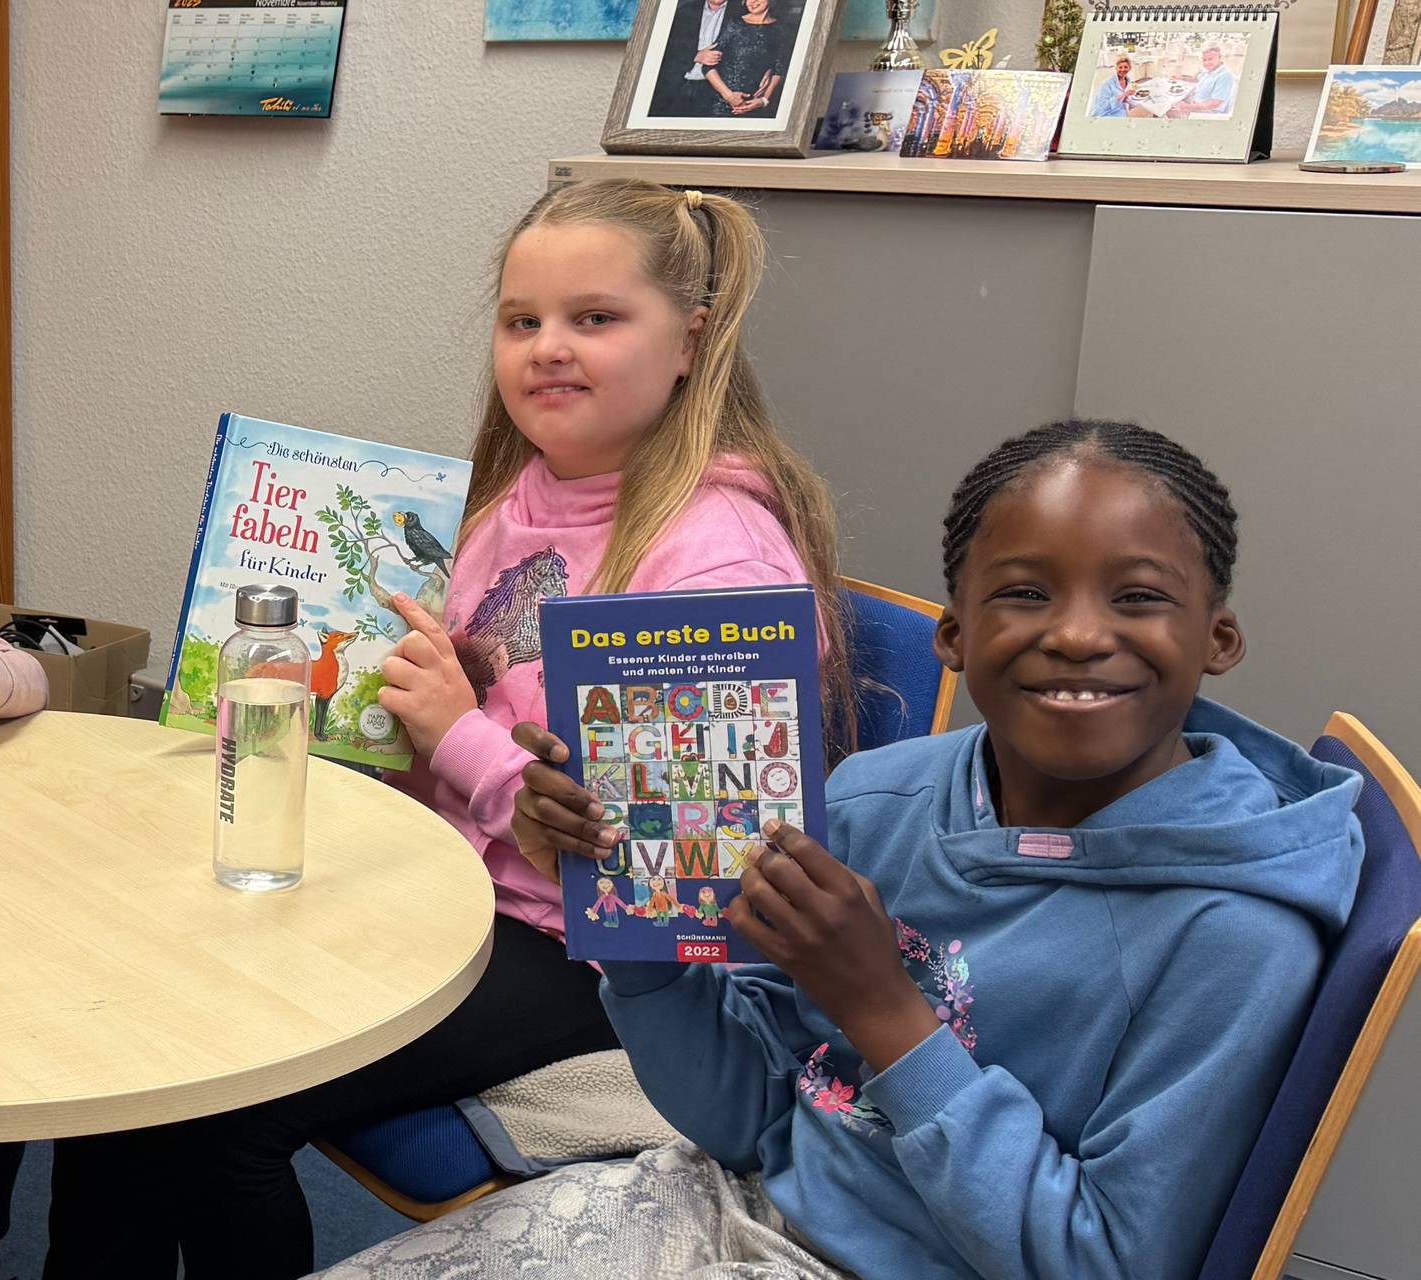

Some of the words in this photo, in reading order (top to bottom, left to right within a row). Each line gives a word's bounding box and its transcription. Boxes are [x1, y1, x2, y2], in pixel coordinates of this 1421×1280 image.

[267, 441, 290, 458] Die
[292, 449, 359, 472] schönsten
[249, 460, 307, 511] Tier
[229, 503, 319, 554] fabeln
[240, 549, 267, 572] für
[269, 557, 327, 583] Kinder
[571, 628, 627, 648] Das
[636, 624, 710, 646] erste
[720, 621, 795, 643] Buch
[608, 654, 655, 665] Essener
[658, 653, 697, 664] Kinder
[700, 651, 760, 662] schreiben
[622, 667, 644, 677] und
[648, 665, 683, 676] malen
[687, 664, 704, 675] für
[707, 663, 747, 674] Kinder
[219, 736, 237, 824] HYDRATE
[684, 946, 720, 957] 2022
